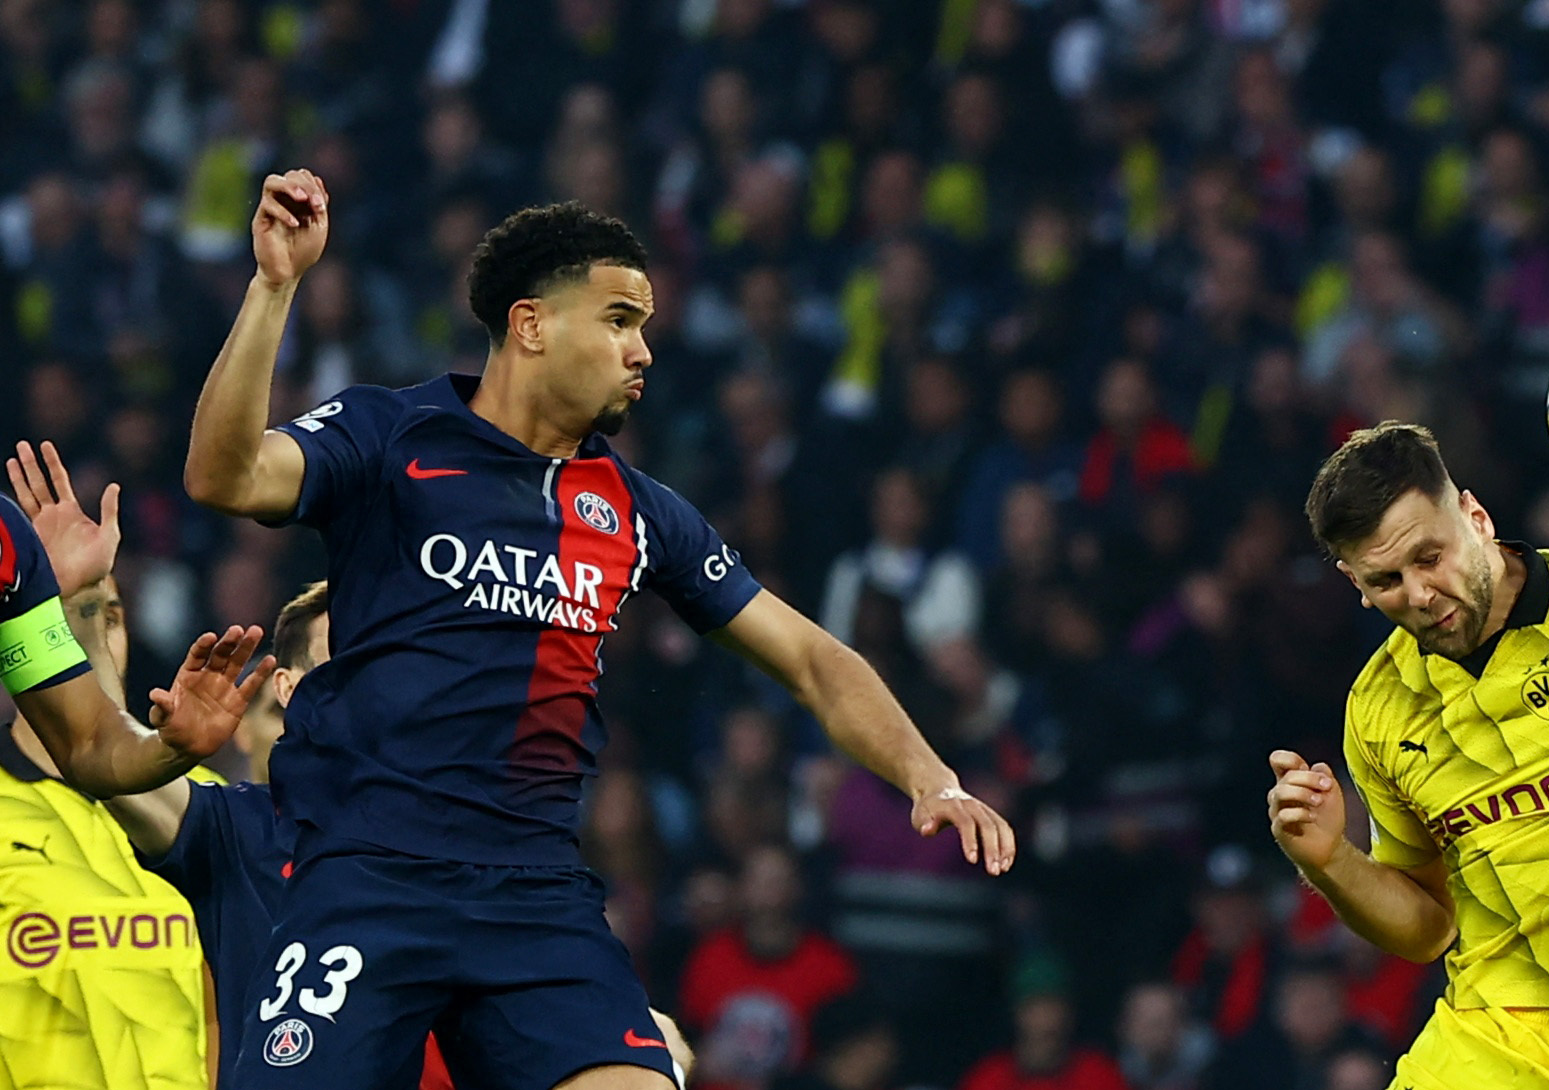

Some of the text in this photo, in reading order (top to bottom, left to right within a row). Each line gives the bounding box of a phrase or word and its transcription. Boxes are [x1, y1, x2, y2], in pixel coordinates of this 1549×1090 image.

[420, 534, 603, 609] QATAR
[464, 583, 597, 633] AIRWAYS
[260, 941, 364, 1024] 33
